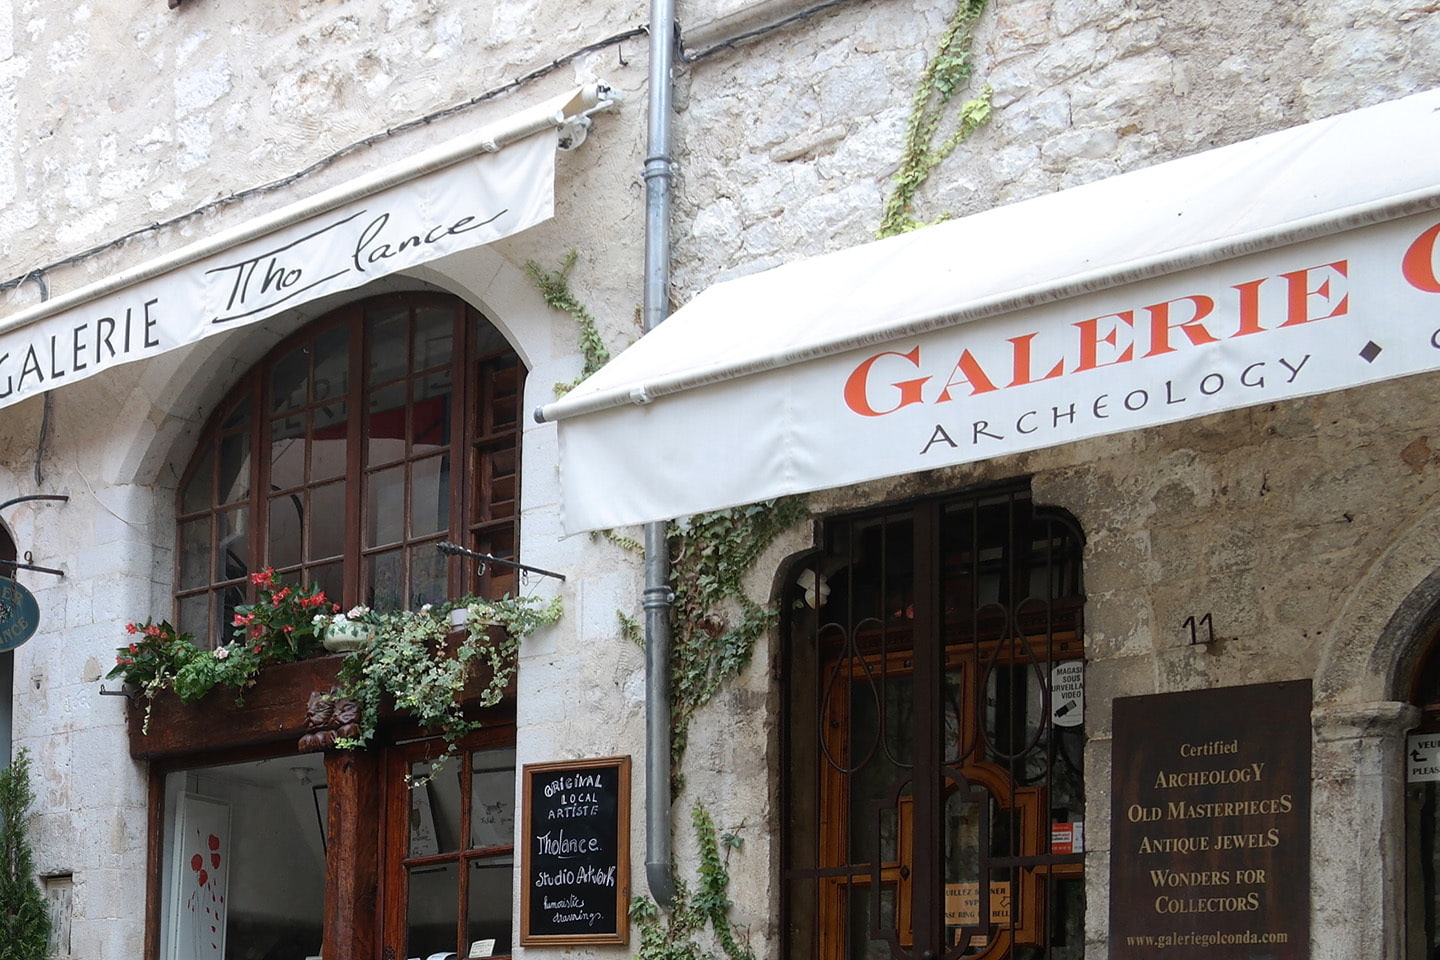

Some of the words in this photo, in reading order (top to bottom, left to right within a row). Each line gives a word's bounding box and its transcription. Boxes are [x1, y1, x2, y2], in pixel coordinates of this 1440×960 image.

[843, 259, 1349, 418] GALERIE
[921, 354, 1312, 456] ARCHEOLOGY
[1182, 613, 1214, 646] 11
[1056, 666, 1083, 676] MAGASI
[1062, 674, 1081, 684] SOUS
[1061, 690, 1082, 699] VIDEO
[1180, 739, 1239, 758] Certified
[1154, 762, 1265, 789] ARCHEOLOGY
[561, 792, 598, 805] LOCAL
[1127, 803, 1162, 823] OLD
[1167, 794, 1293, 821] MASTERPIECES
[1138, 833, 1210, 855] ANTIQUE
[1150, 869, 1230, 888] WONDERS
[1236, 868, 1266, 886] FOR
[946, 888, 972, 897] UILLEZ
[1155, 892, 1260, 915] COLLECTORS
[1126, 929, 1289, 948] www.galeriegolconda.com
